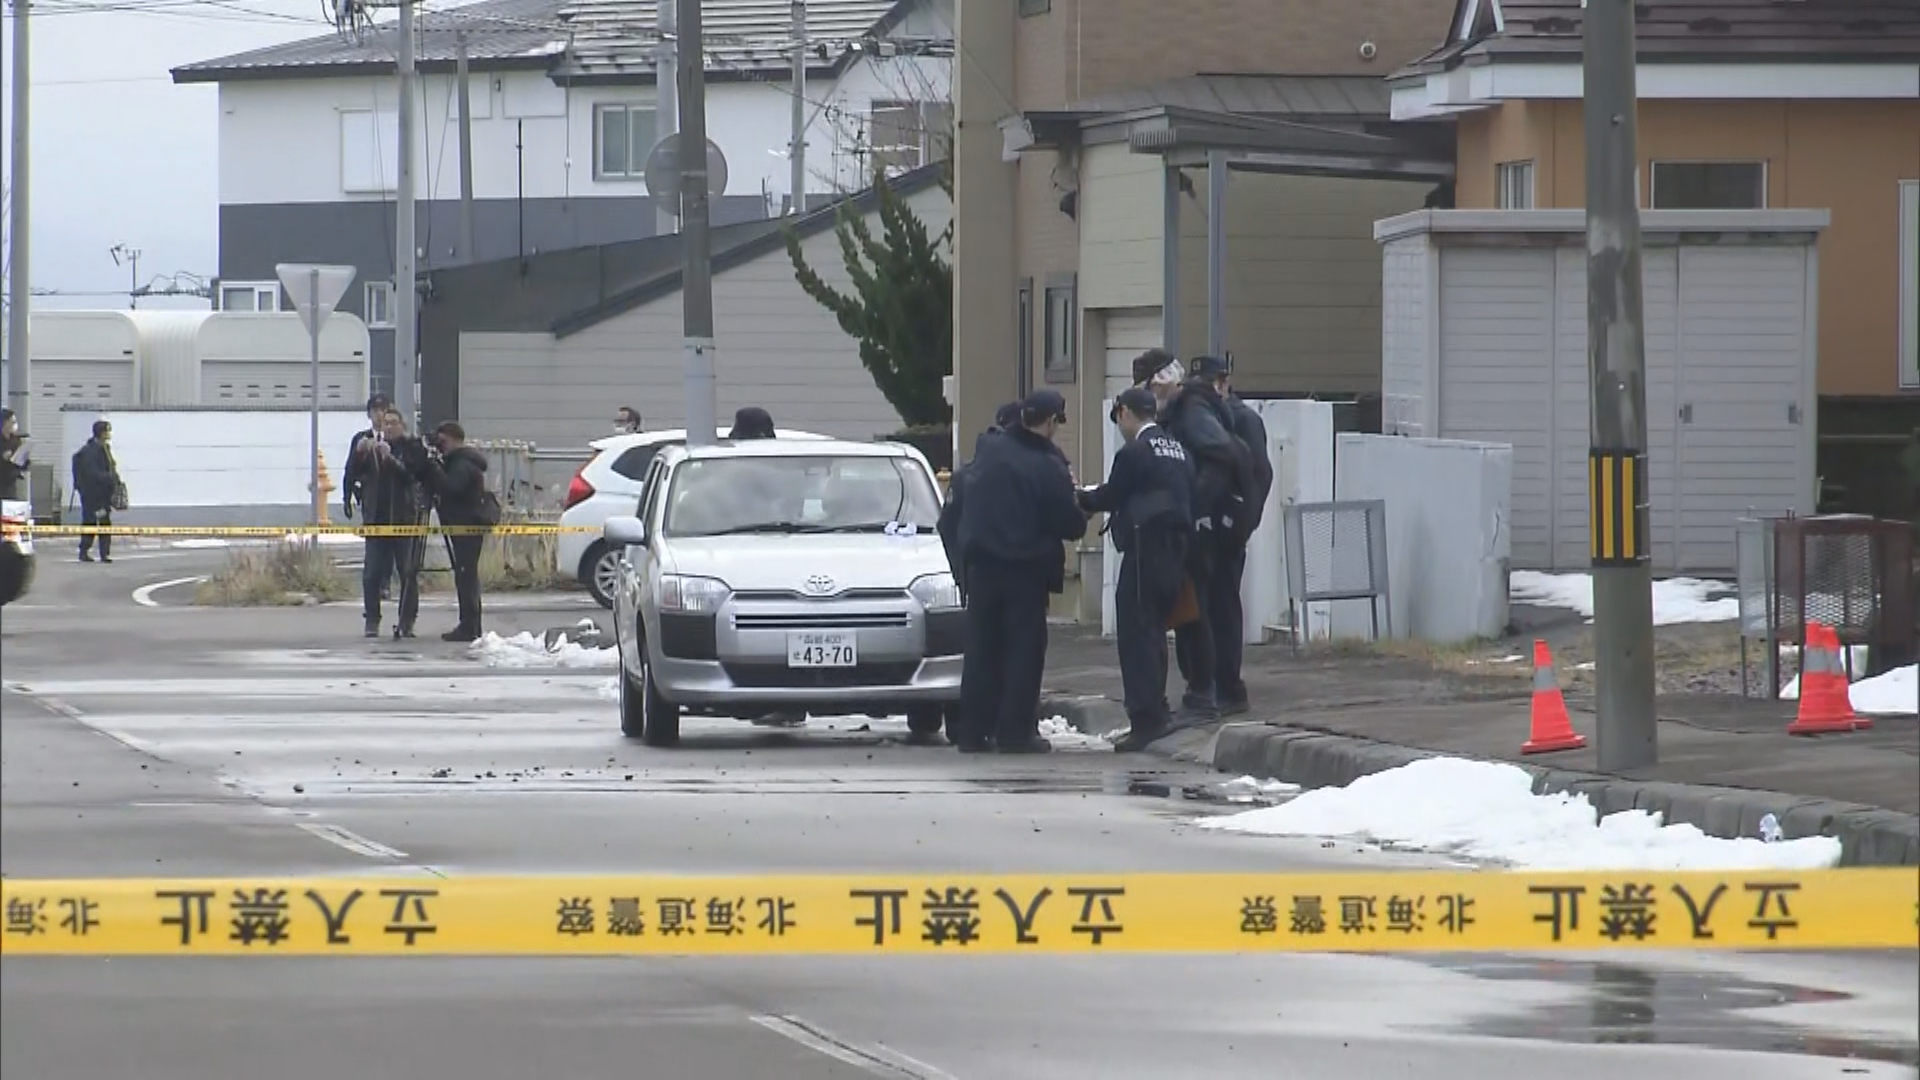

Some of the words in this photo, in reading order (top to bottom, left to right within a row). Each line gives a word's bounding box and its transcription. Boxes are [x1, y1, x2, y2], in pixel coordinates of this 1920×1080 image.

[804, 646, 853, 664] 43-70
[6, 899, 99, 934] 北海
[157, 890, 437, 944] 立入禁止
[558, 898, 795, 935] 北海道警察
[850, 888, 1124, 945] 立入禁止
[1241, 895, 1473, 933] 北海道警察
[1529, 884, 1800, 940] 立入禁止
